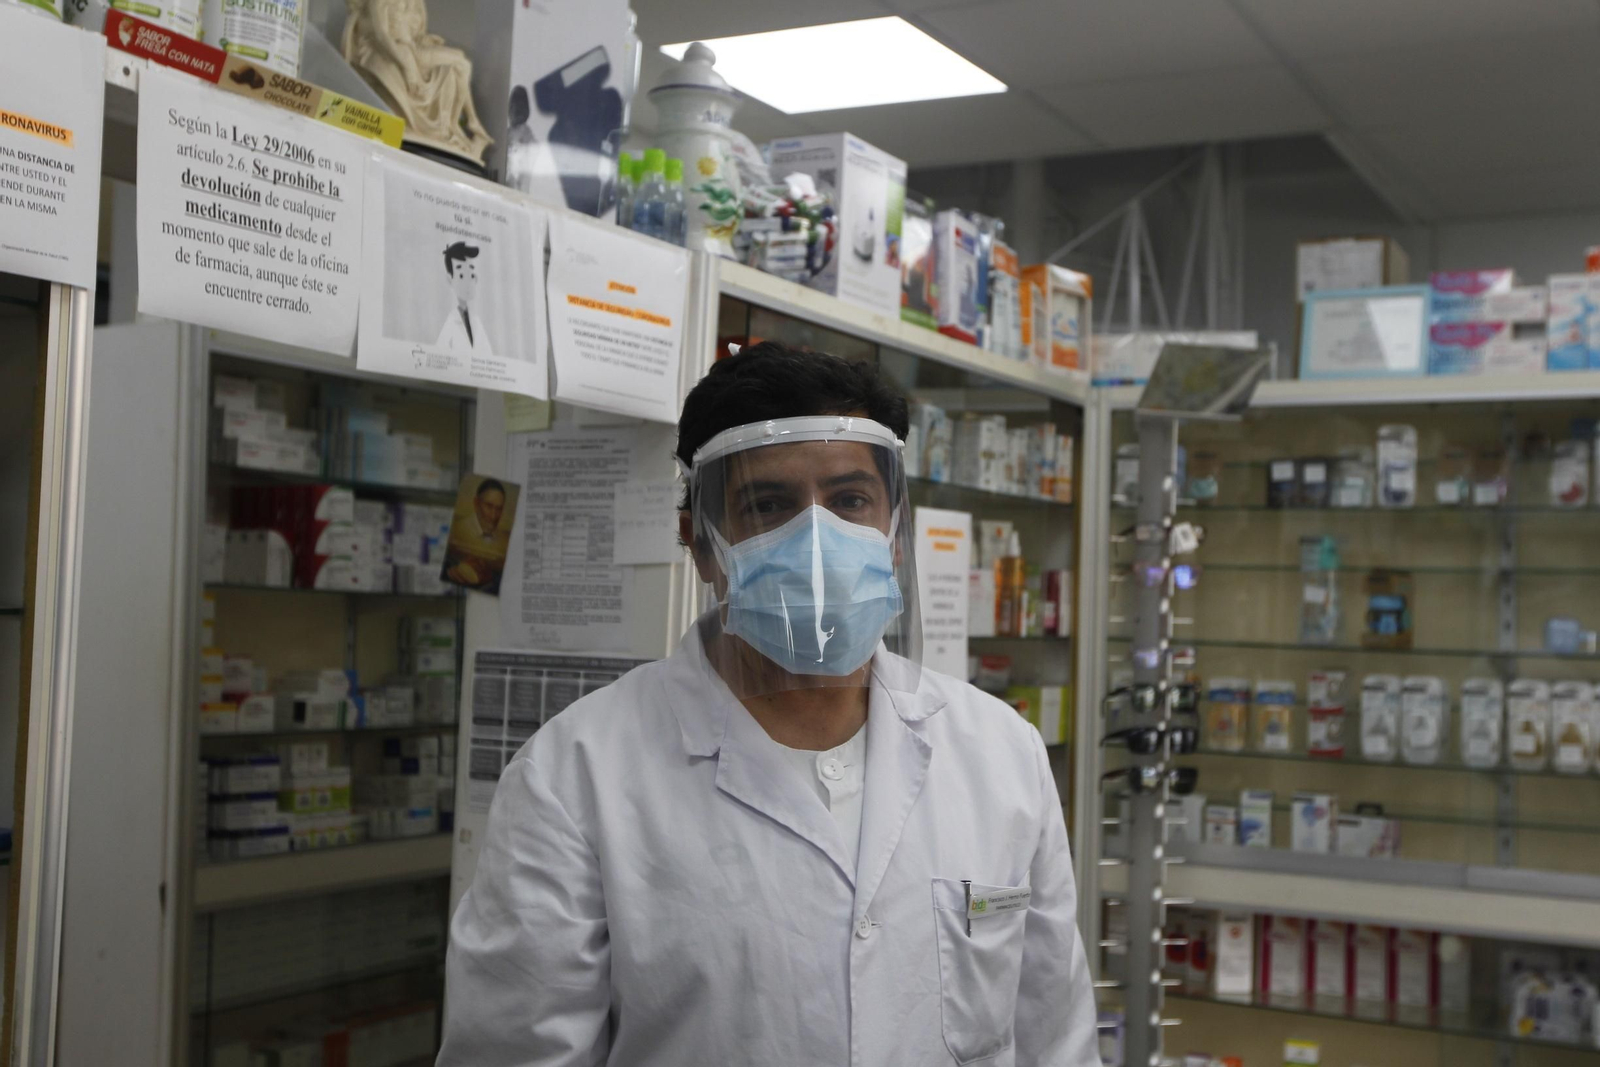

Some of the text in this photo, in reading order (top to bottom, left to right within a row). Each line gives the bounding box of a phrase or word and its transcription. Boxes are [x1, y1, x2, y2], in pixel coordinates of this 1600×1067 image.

[137, 26, 172, 46] SABOR
[134, 36, 216, 75] FRESA CON NATA
[268, 73, 312, 99] SABOR
[263, 90, 311, 114] CHOCOLATE
[344, 103, 382, 124] VAINILLA
[341, 114, 383, 136] con canela
[168, 107, 346, 175] Según la Ley 29/2006 en su
[17, 150, 63, 170] DISTANCIA
[64, 163, 75, 174] DE
[176, 142, 340, 198] artículo 2.6. Se prohíbe la
[22, 167, 50, 183] USTED
[51, 174, 57, 184] Y
[58, 176, 67, 188] EL
[26, 184, 65, 203] DURANTE
[181, 167, 336, 222] devolución de cualquier
[423, 193, 434, 202] no
[435, 196, 460, 210] puedo
[461, 204, 479, 215] estar
[481, 209, 491, 218] en
[14, 198, 25, 209] LA
[27, 200, 58, 216] MISMA
[185, 199, 332, 247] medicamento desde el
[161, 220, 349, 275] momento que sale de la oficina
[175, 246, 338, 296] de farmacia, aunque éste se
[204, 280, 312, 315] encuentre cerrado.
